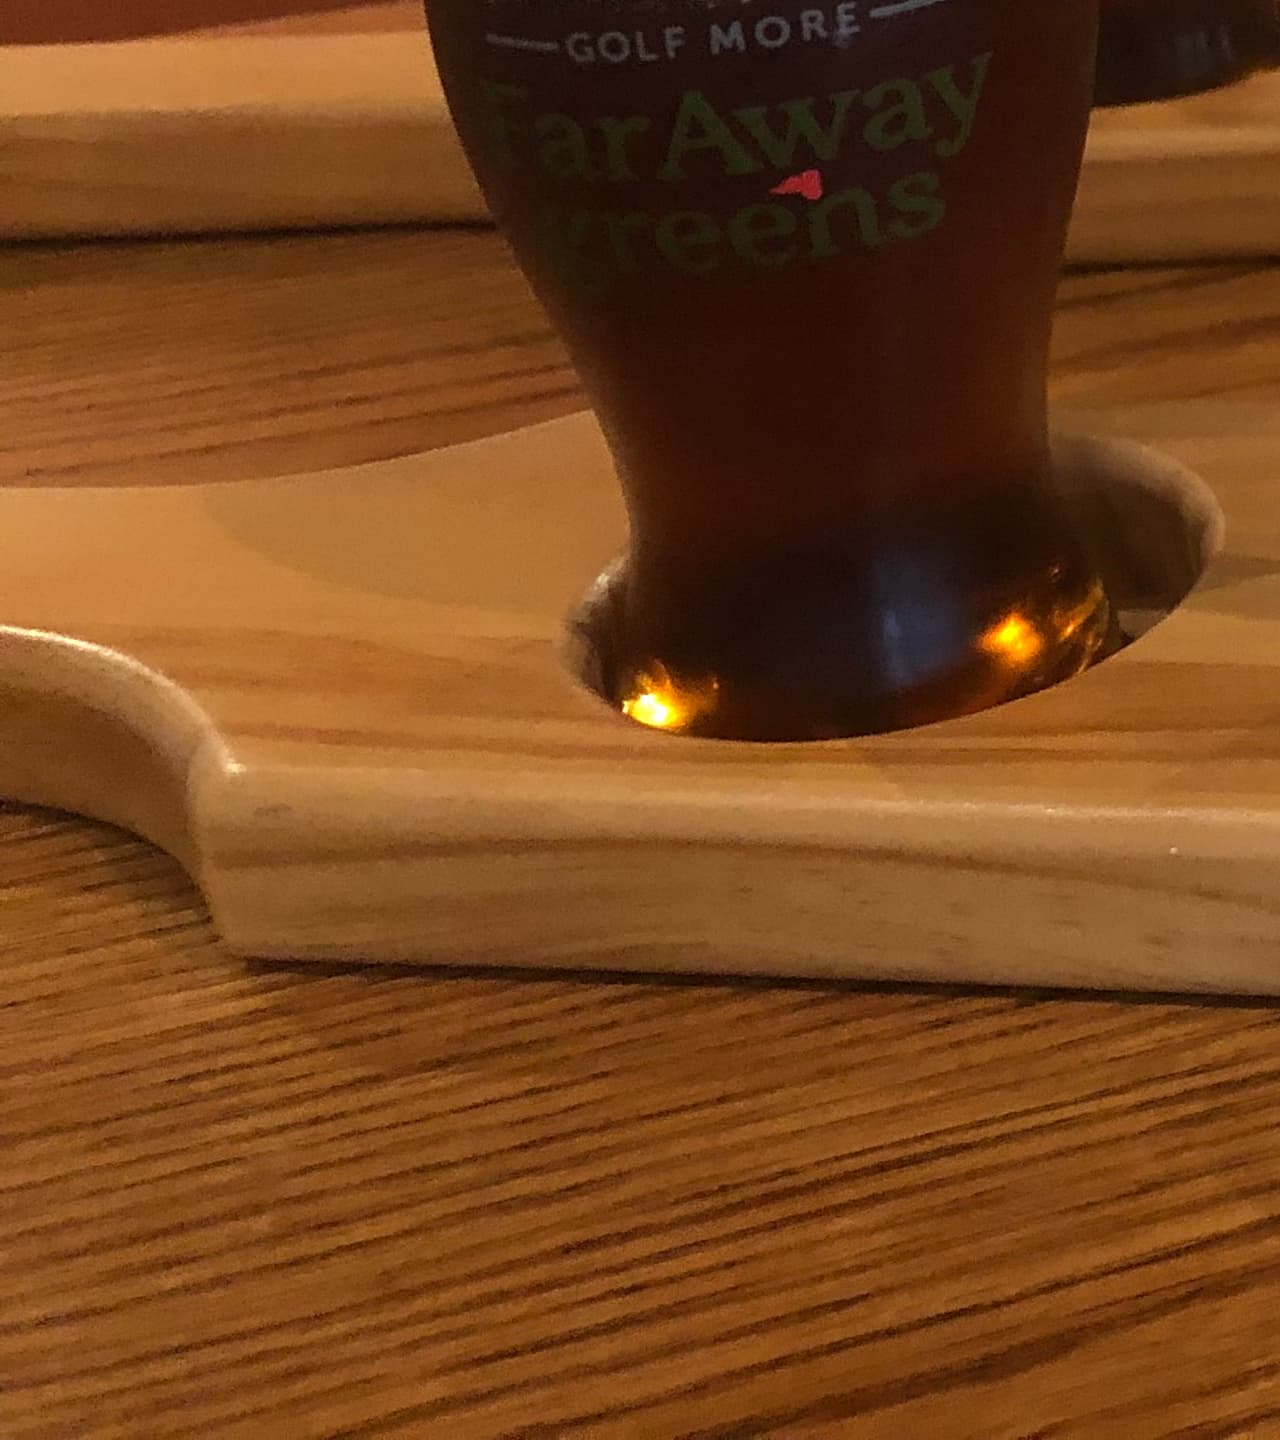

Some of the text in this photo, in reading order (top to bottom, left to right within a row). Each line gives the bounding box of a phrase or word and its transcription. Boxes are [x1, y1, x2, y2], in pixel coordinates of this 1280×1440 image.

[564, 1, 862, 64] GOLF MORE
[476, 50, 994, 184] FarAway
